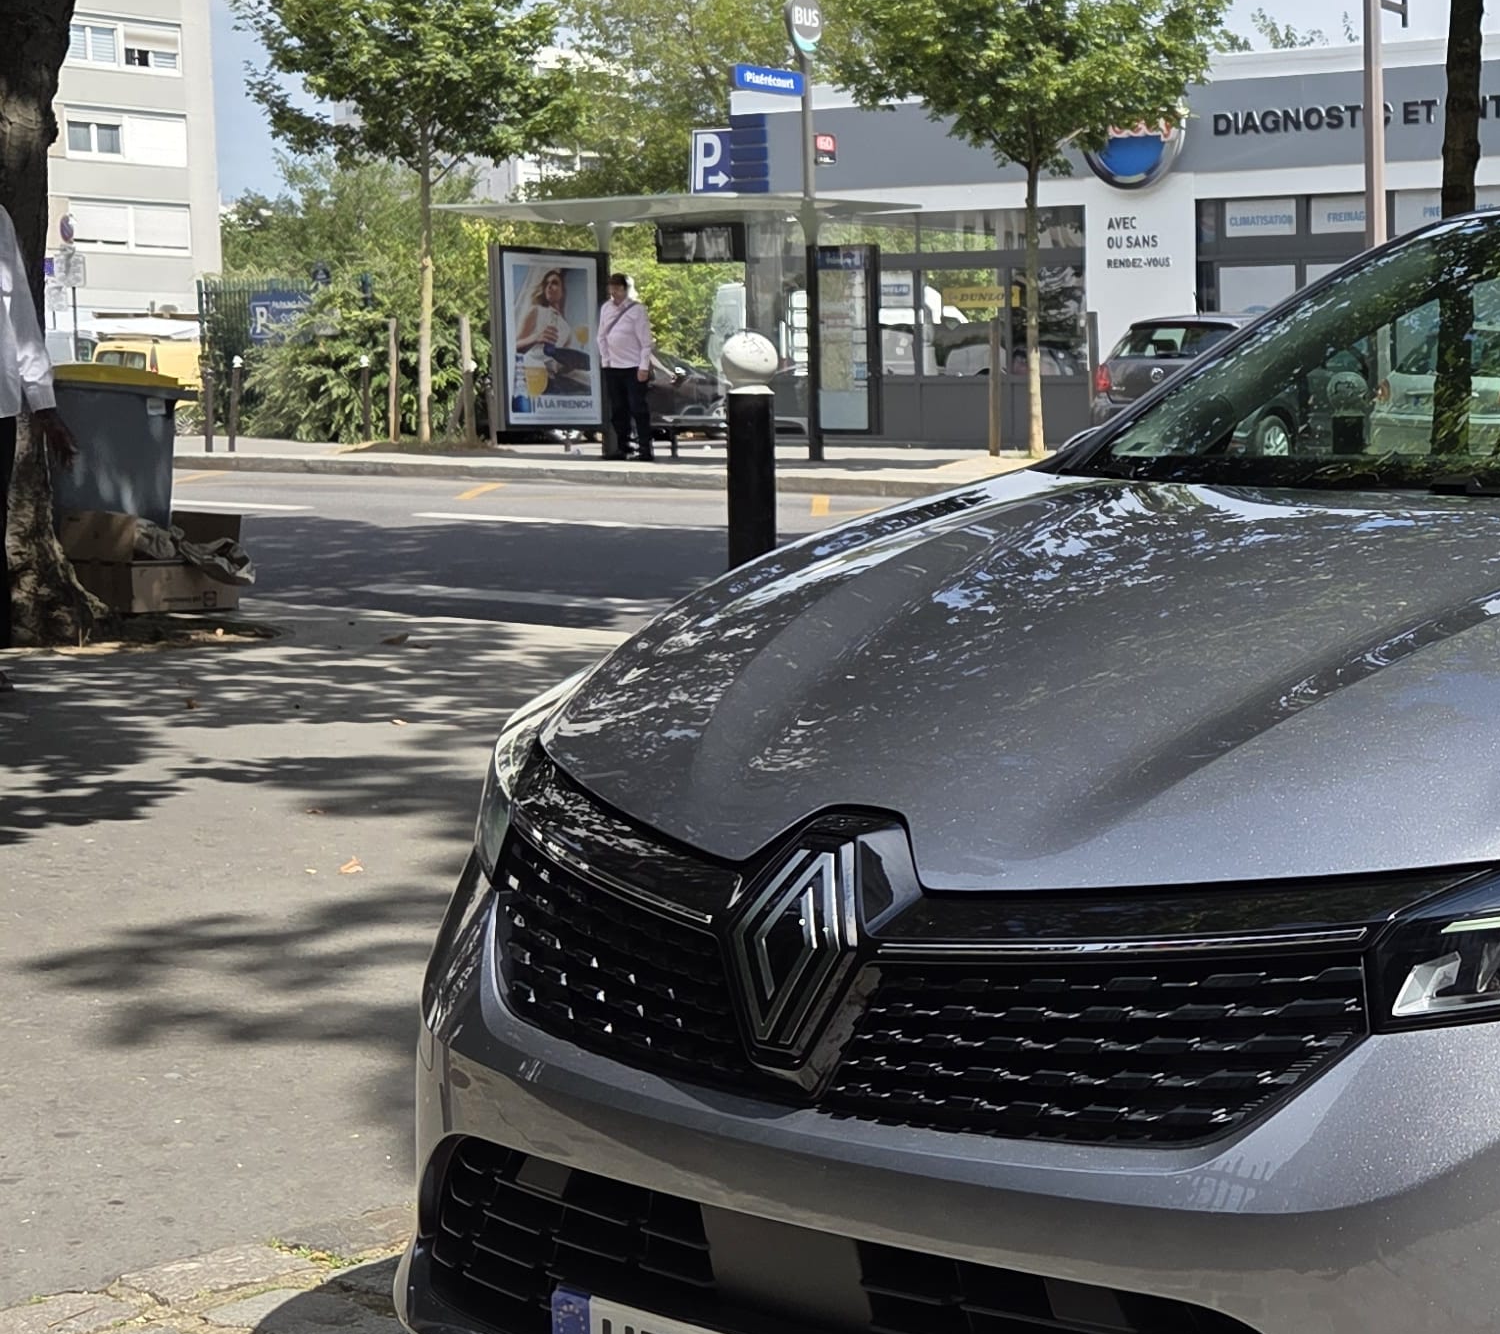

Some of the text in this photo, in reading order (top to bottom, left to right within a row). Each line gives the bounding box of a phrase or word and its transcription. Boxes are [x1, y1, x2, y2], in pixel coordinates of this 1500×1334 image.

[793, 5, 820, 28] BUS
[744, 71, 795, 90] Pixérécourt
[1213, 100, 1394, 136] DIAGNOST
[1403, 98, 1440, 125] ET
[695, 133, 722, 190] P
[1229, 213, 1293, 227] CLIMATISATION
[1327, 210, 1366, 223] FREINAG
[1107, 217, 1137, 231] AVEC
[1107, 235, 1159, 249] OU SANS
[1106, 257, 1171, 269] RENDEZ-VOUS
[960, 293, 1005, 301] DUNLO
